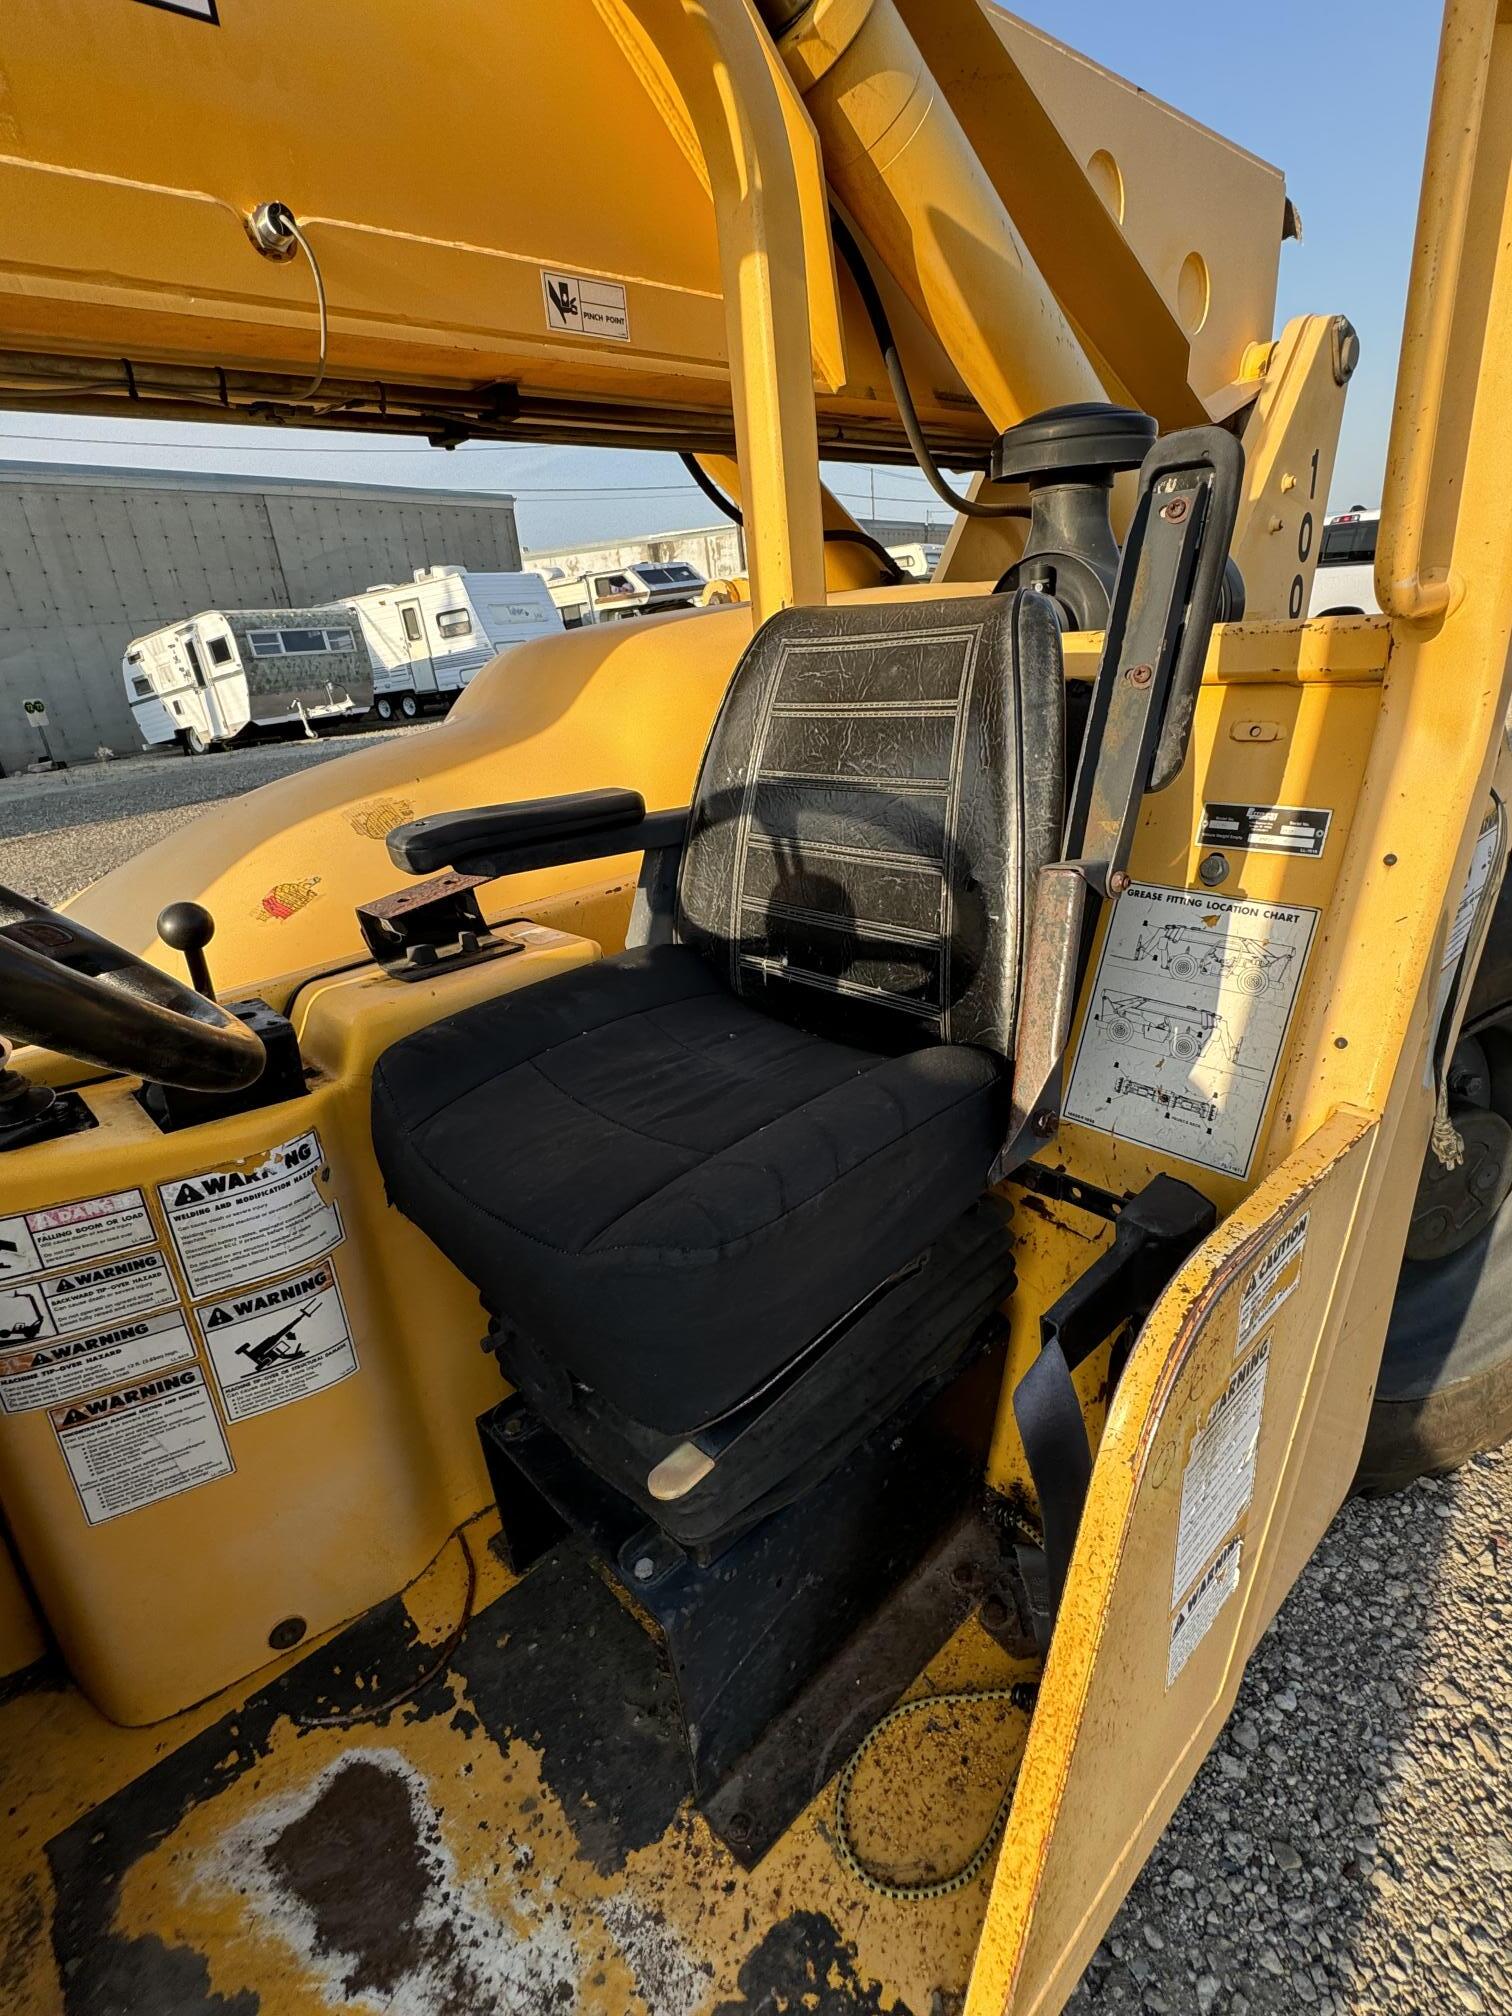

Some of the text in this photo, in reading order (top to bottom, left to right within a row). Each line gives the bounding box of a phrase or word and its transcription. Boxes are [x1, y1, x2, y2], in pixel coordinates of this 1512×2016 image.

[584, 312, 624, 325] PINCH POINT
[1127, 888, 1300, 924] GREASE FITTING LOCATION CHART
[201, 1144, 311, 1196] WANG
[173, 1208, 210, 1221] WELDING
[215, 1202, 231, 1211] AND
[236, 1181, 291, 1204] MODIFICATION
[37, 1231, 72, 1242] FALLING
[75, 1223, 103, 1233] BOOM
[122, 1212, 143, 1222] LOAD
[1259, 1215, 1308, 1280] CAUTION
[75, 1257, 156, 1284] WARNING
[51, 1272, 162, 1306] BACKWARD TIP-OVER HAZARD
[234, 1272, 327, 1314] WARNING
[51, 1324, 148, 1358] WARNING
[1, 1349, 121, 1385] MACHINE TIP-OVER HAZARD
[86, 1373, 194, 1414] WARNING
[1187, 1534, 1240, 1613] WARNIN
